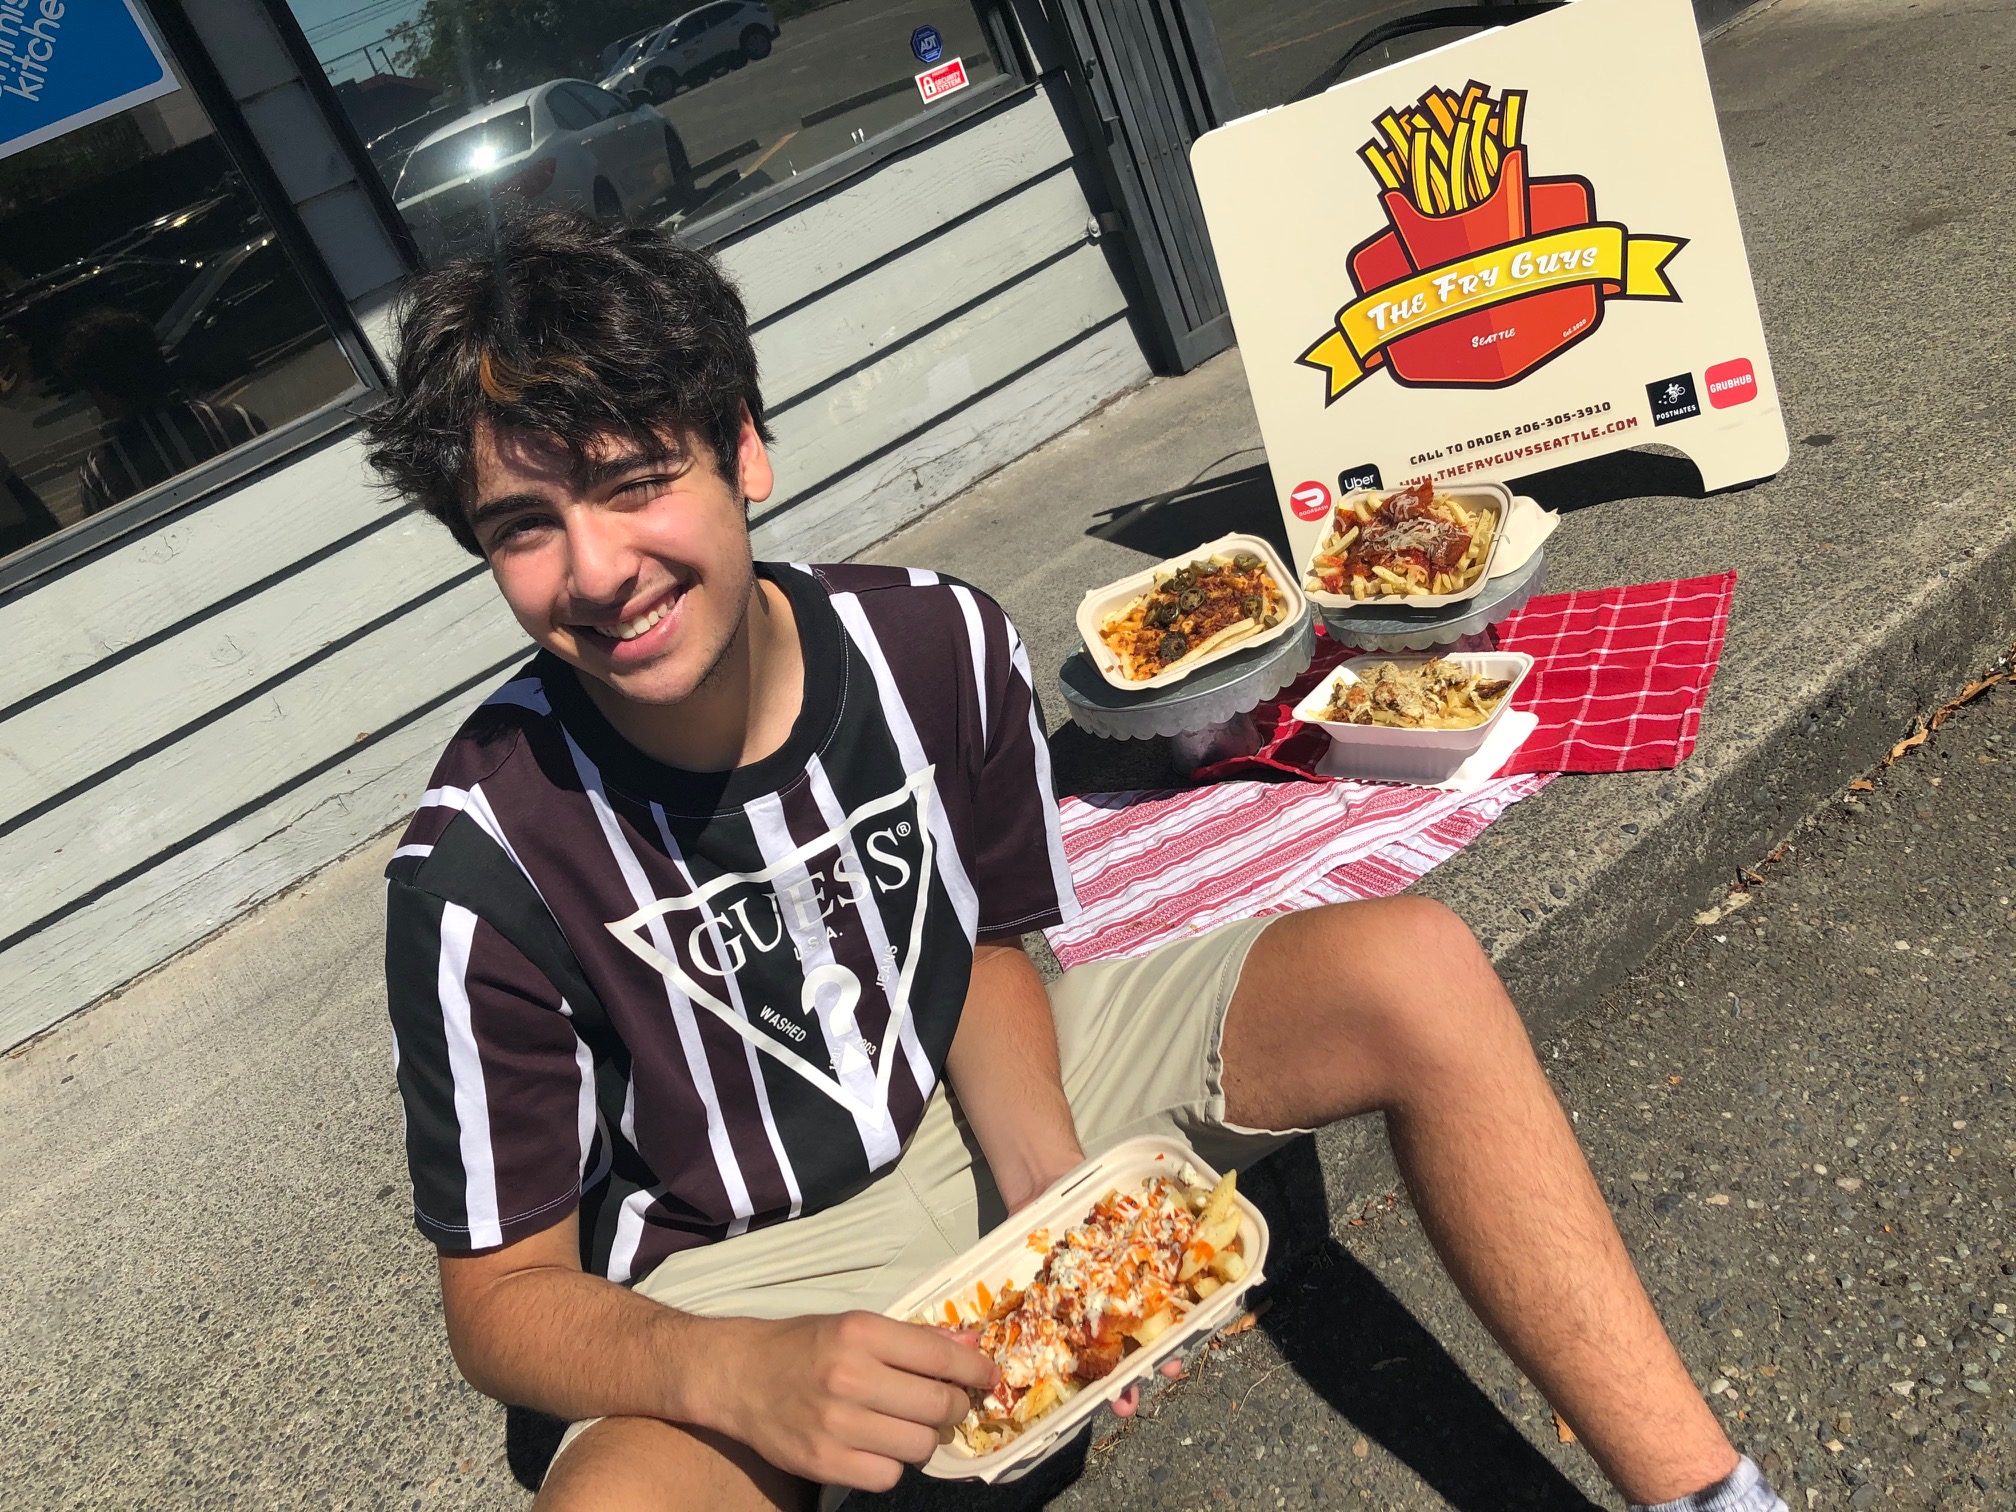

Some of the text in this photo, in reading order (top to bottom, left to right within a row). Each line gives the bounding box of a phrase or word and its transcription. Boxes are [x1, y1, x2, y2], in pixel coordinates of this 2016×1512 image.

[920, 35, 937, 53] ADT
[934, 71, 961, 87] SECURITY
[936, 78, 962, 93] SYSTEM
[1367, 247, 1598, 331] THE FRY GUYS
[1471, 327, 1516, 348] SEATTLE
[1709, 374, 1753, 394] GRUBHUB
[1656, 404, 1697, 421] POSTMATES
[1410, 401, 1611, 466] CALL TO ORDER 206-305-3910
[1344, 474, 1375, 490] Uber
[793, 925, 843, 961] U.S.A.
[876, 945, 898, 991] JEANS
[760, 1004, 807, 1043] WASHED
[856, 1036, 877, 1056] 1203
